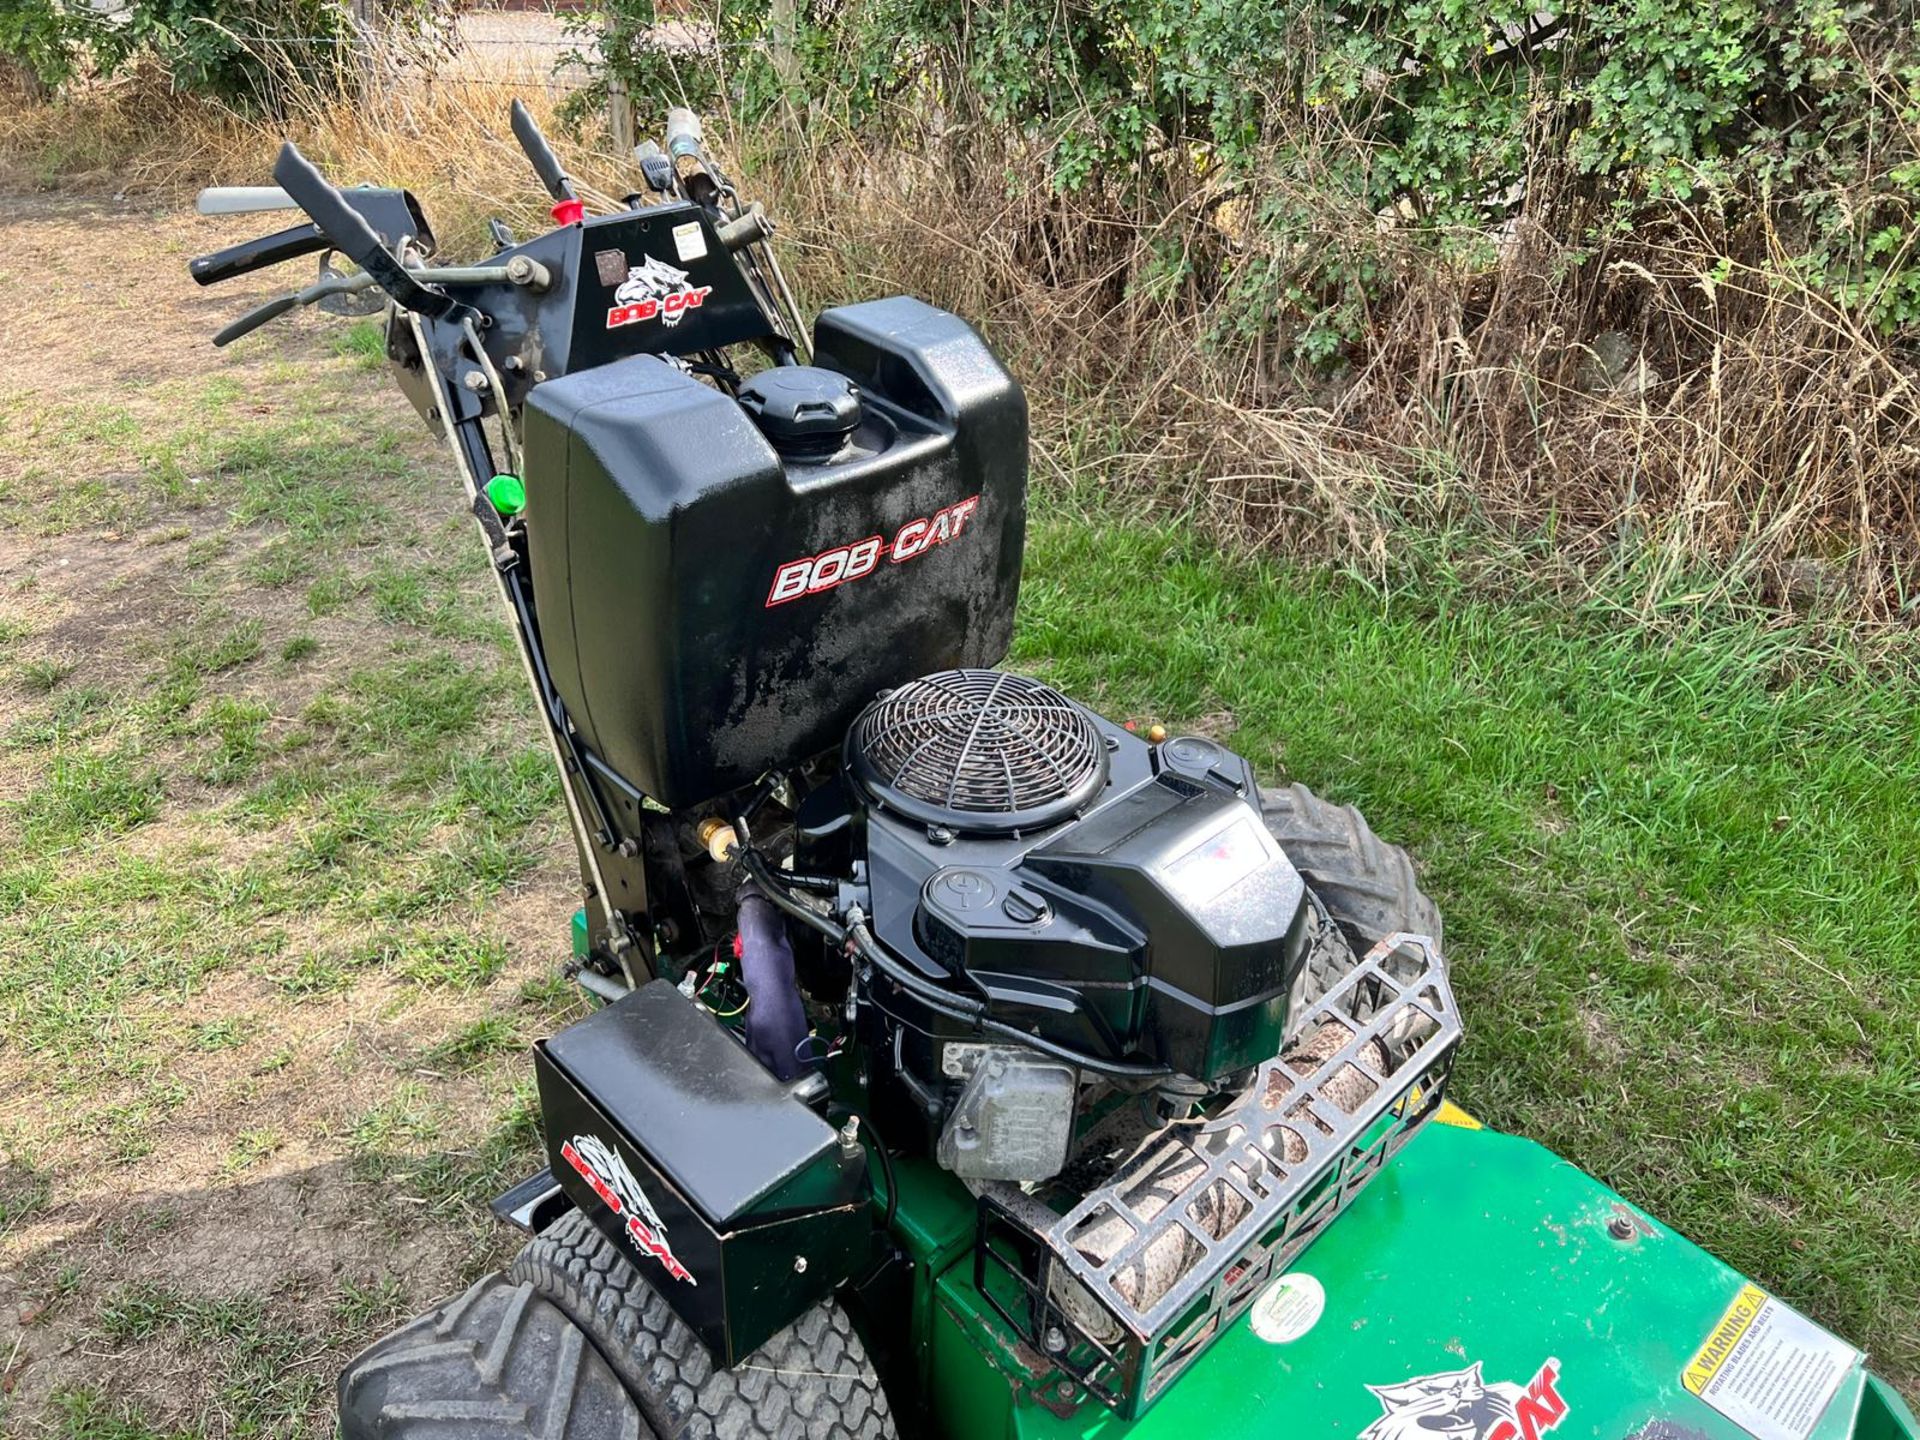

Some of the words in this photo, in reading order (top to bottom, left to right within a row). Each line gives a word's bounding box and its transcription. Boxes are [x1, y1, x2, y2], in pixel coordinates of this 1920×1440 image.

[767, 497, 979, 607] BOB-CAT
[1225, 1092, 1334, 1199] HOT
[1697, 1302, 1753, 1372] WARNING
[1708, 1362, 1735, 1395] ROTATING
[1730, 1337, 1752, 1364] BLADES
[1747, 1324, 1761, 1340] AND
[1756, 1305, 1774, 1326] BELTS
